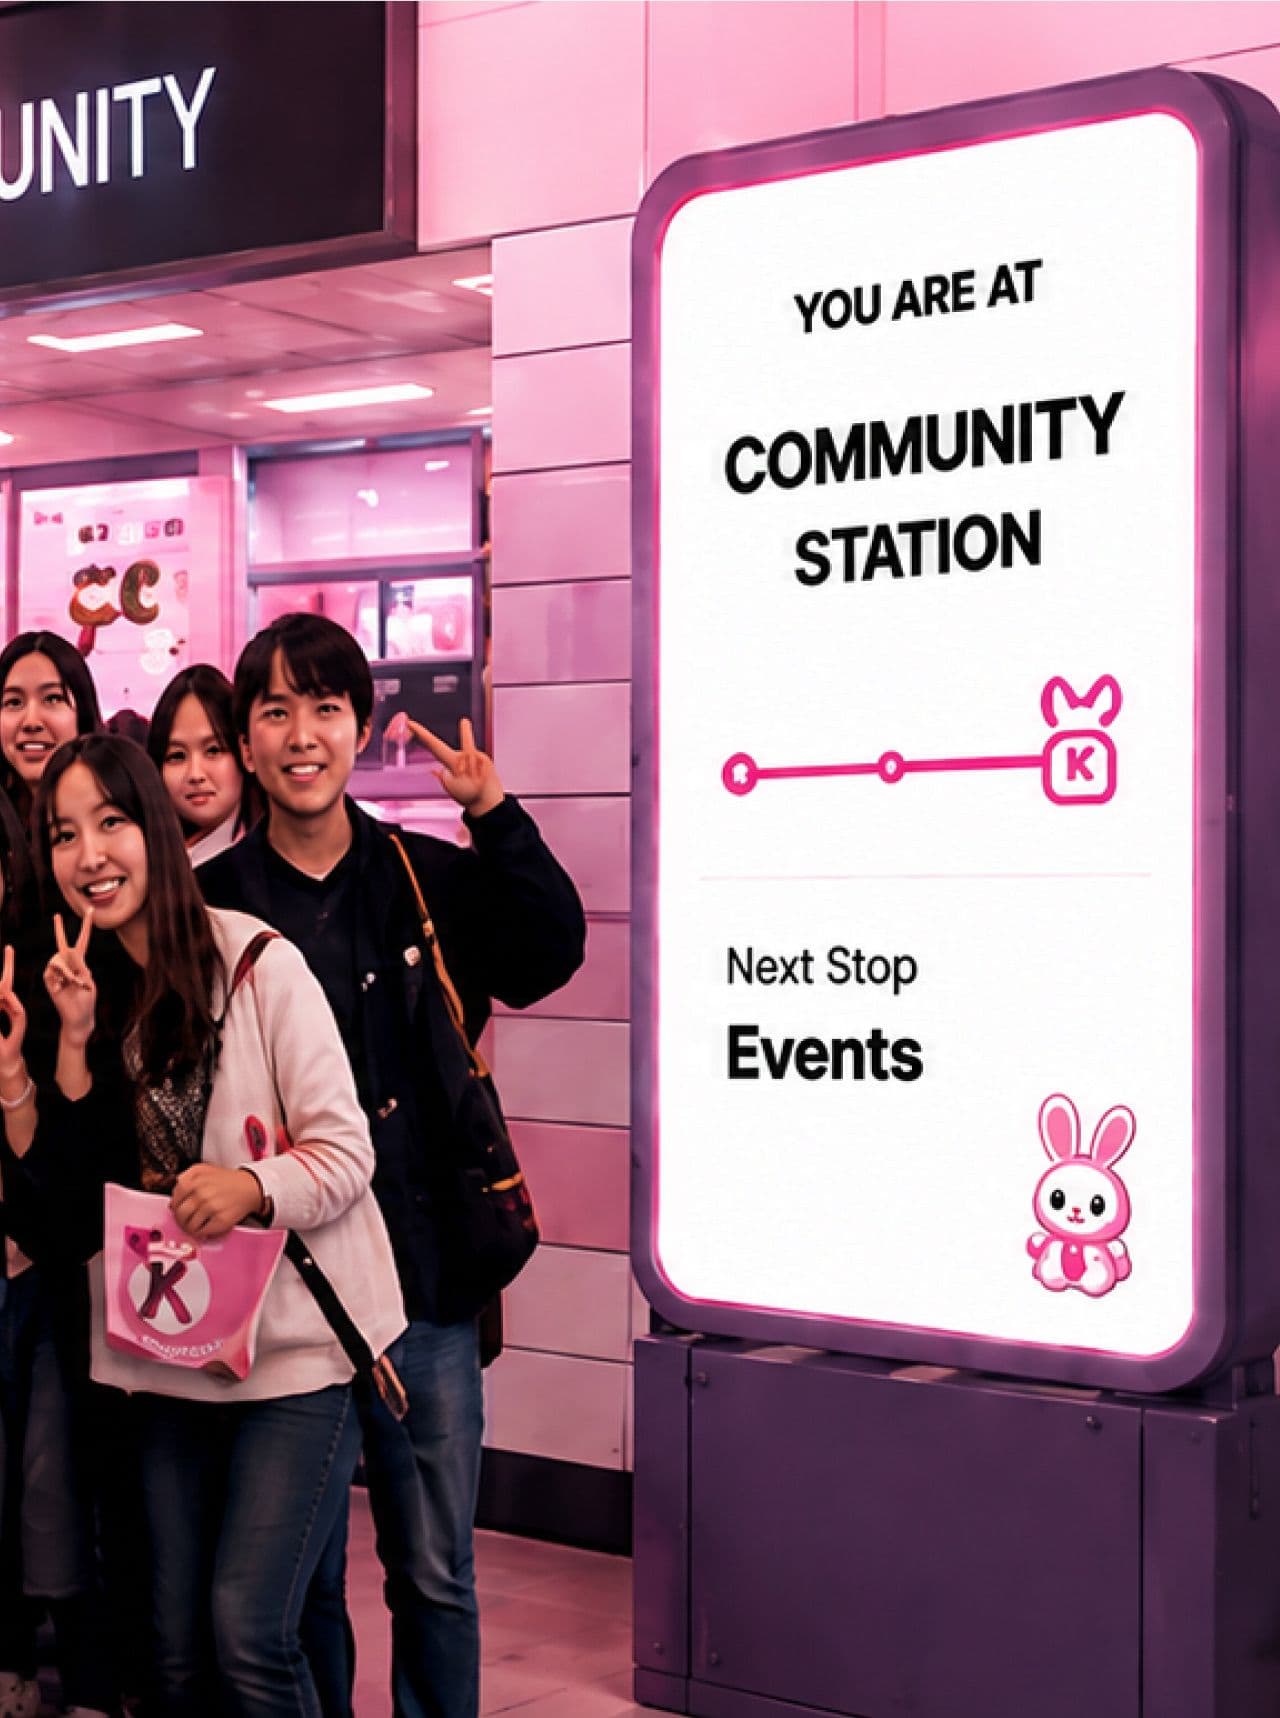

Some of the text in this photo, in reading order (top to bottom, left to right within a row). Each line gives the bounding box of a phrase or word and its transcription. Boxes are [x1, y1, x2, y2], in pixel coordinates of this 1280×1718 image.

[793, 258, 1044, 334] YOU ARE AT
[724, 391, 1126, 495] COMMUNITY
[795, 509, 1042, 587] STATION
[1066, 745, 1095, 782] K
[727, 945, 918, 996] Next Stop
[728, 1024, 924, 1082] Events
[138, 1260, 192, 1325] K
